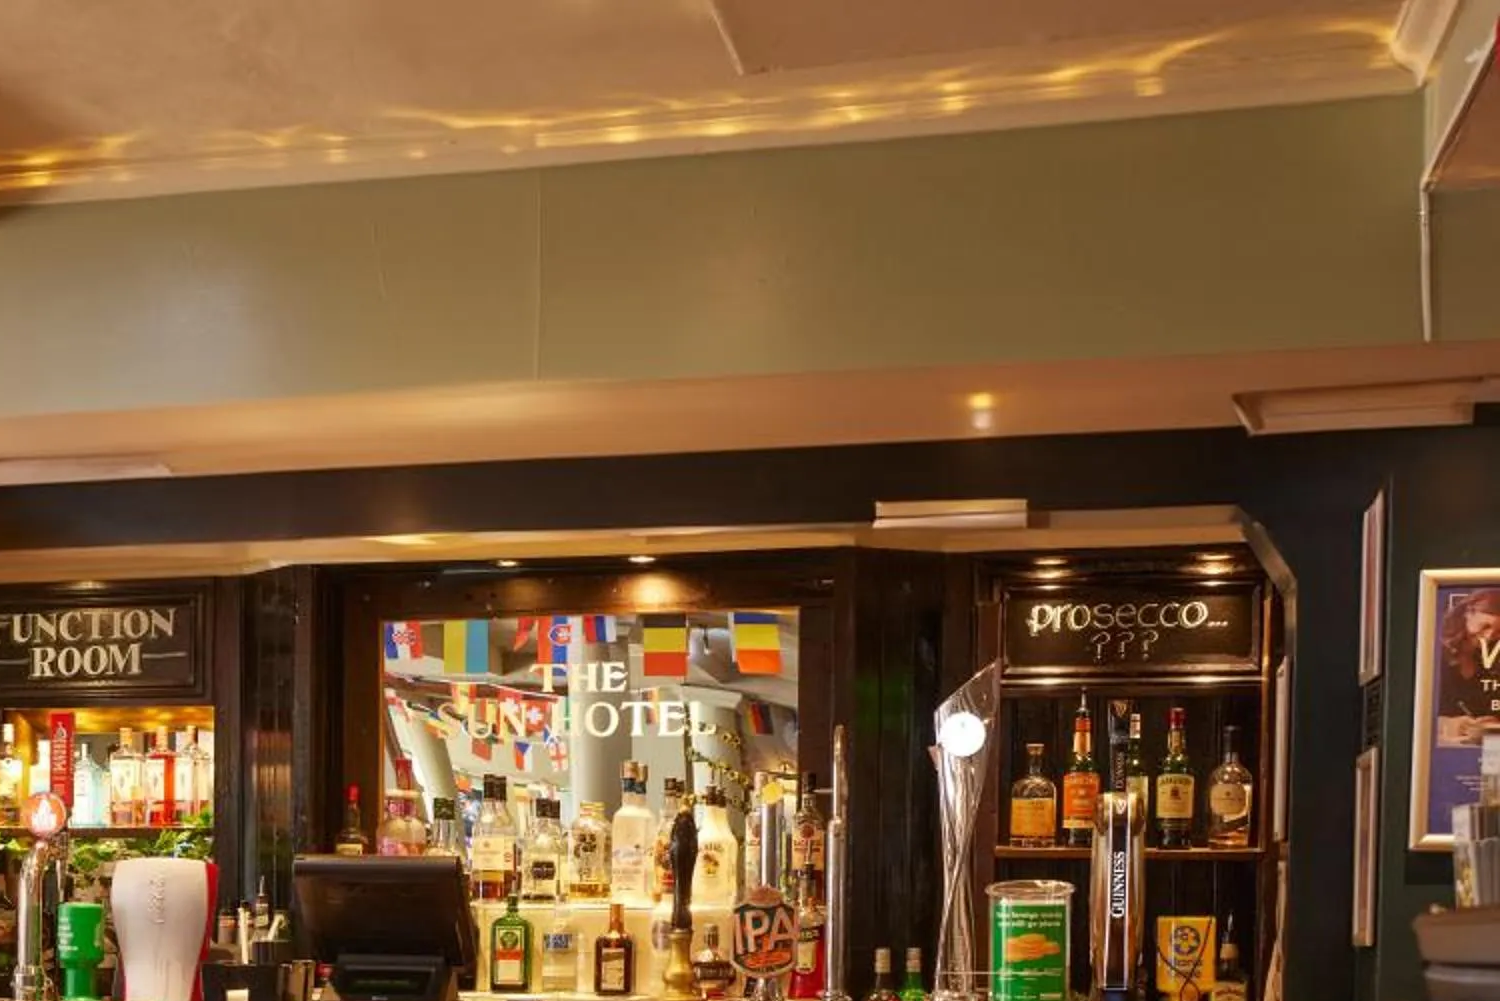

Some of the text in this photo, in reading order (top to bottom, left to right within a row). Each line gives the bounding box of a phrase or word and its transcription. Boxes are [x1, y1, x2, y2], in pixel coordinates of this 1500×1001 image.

[28, 643, 142, 680] ROOM
[530, 661, 628, 693] THE
[437, 700, 717, 739] SUN HOTEL
[1110, 850, 1126, 918] GUINNESS
[733, 905, 799, 955] IPA
